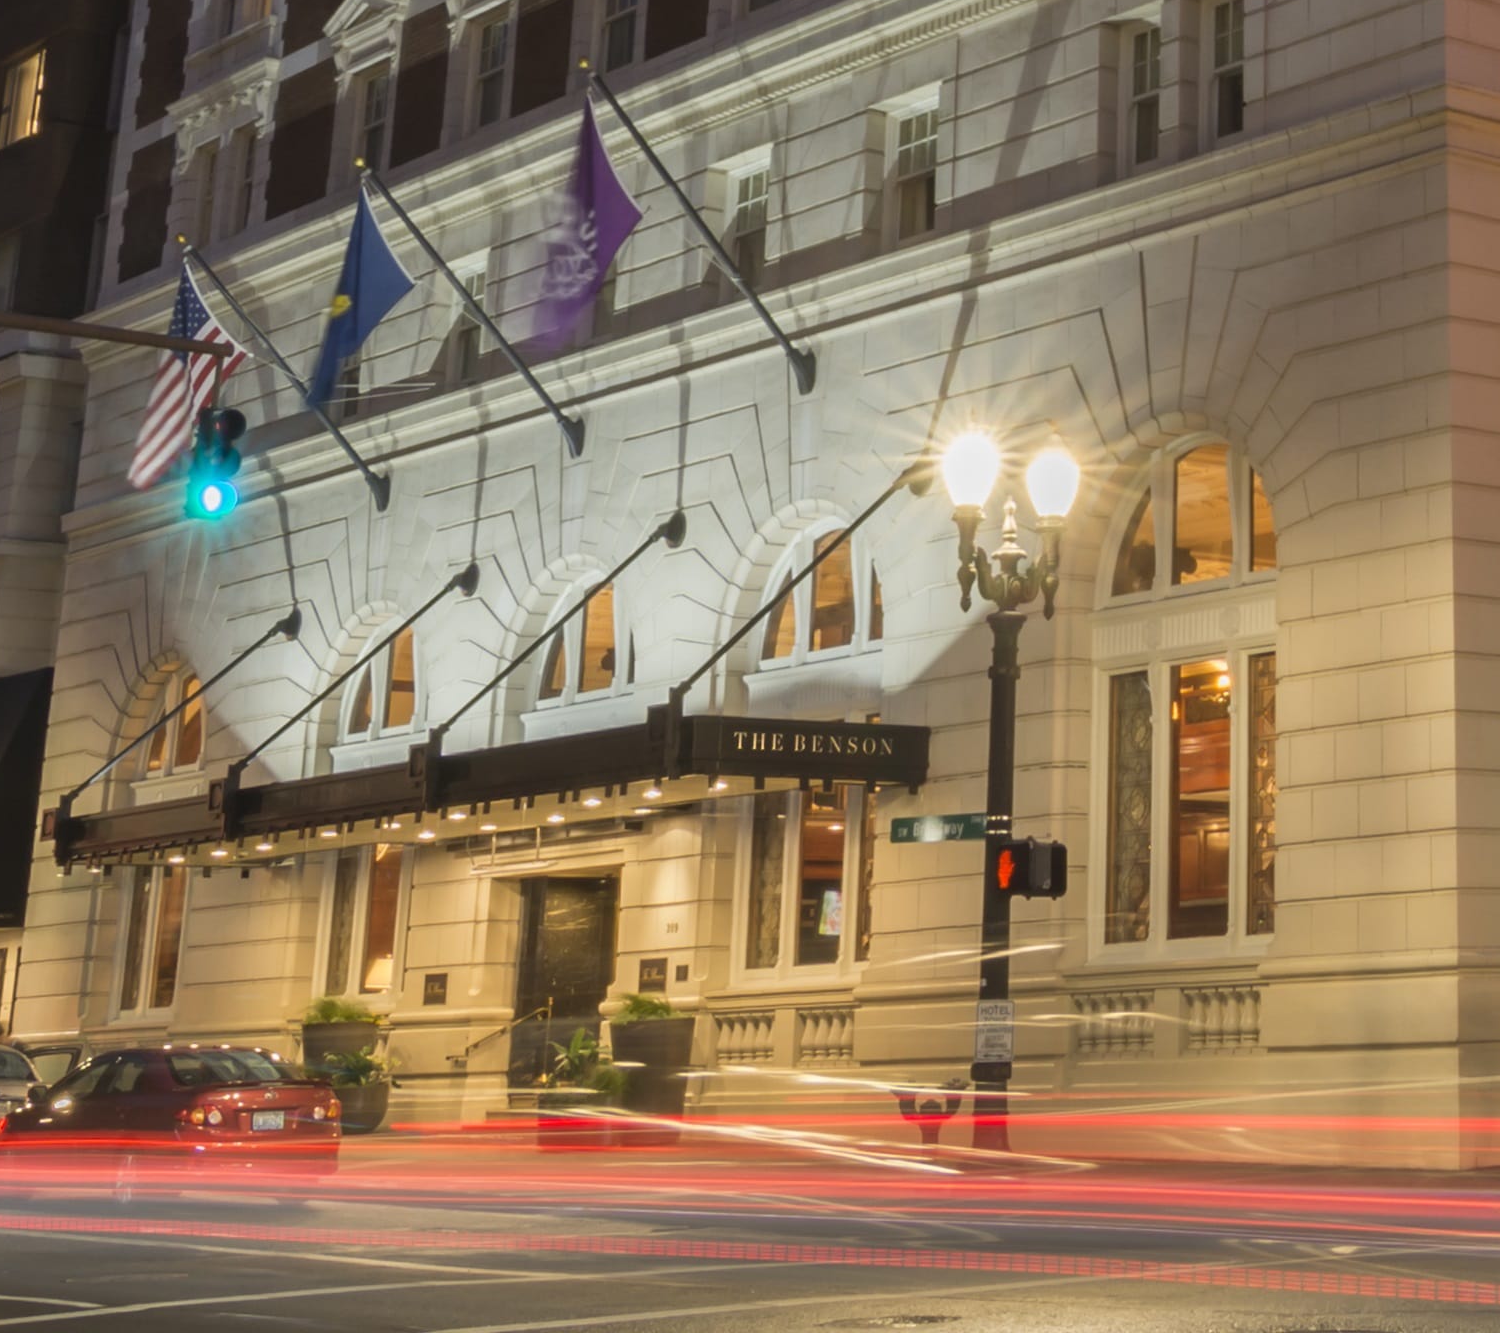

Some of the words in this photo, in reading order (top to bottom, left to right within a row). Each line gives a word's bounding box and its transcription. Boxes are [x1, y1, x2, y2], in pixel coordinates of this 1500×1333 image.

[733, 731, 784, 752] THE
[793, 733, 894, 756] BENSON
[913, 821, 964, 840] Bway
[981, 1005, 1011, 1015] HOTEL
